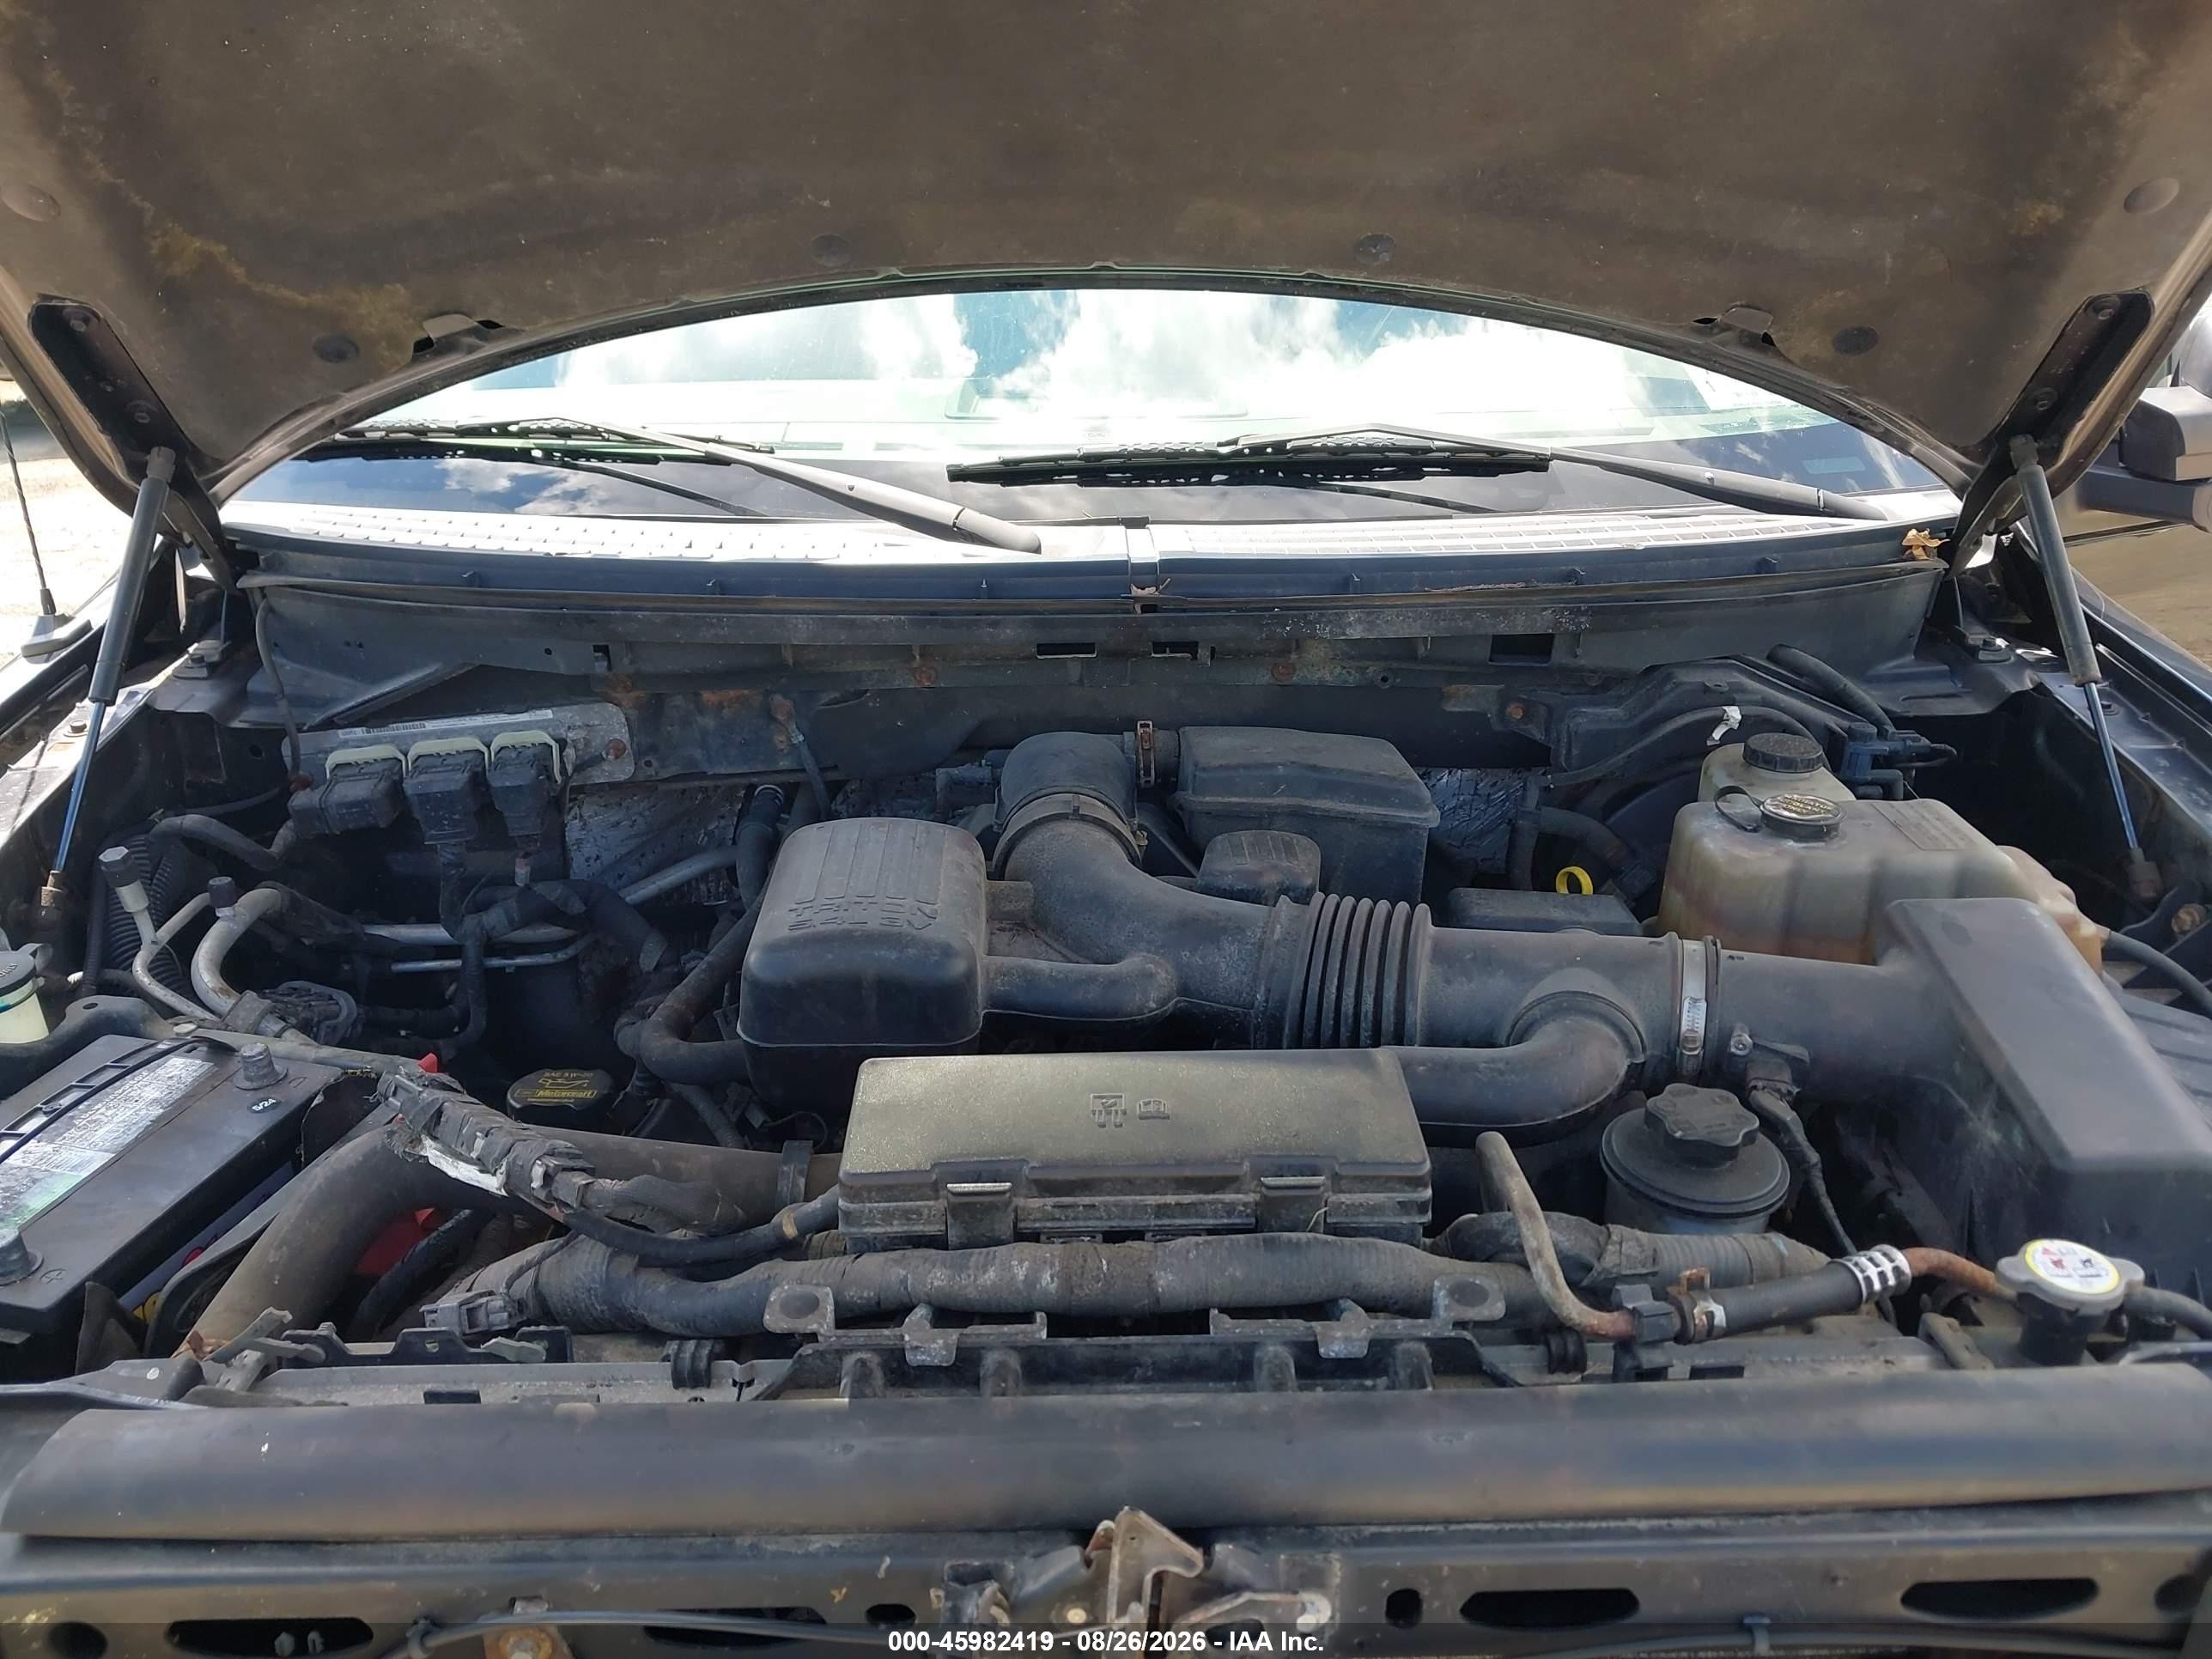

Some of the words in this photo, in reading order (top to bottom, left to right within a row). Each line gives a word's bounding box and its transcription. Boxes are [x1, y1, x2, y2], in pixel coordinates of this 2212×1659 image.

[787, 902, 938, 920] TRITON
[537, 1089, 593, 1098] Motorcraft
[252, 1098, 276, 1111] 5/24
